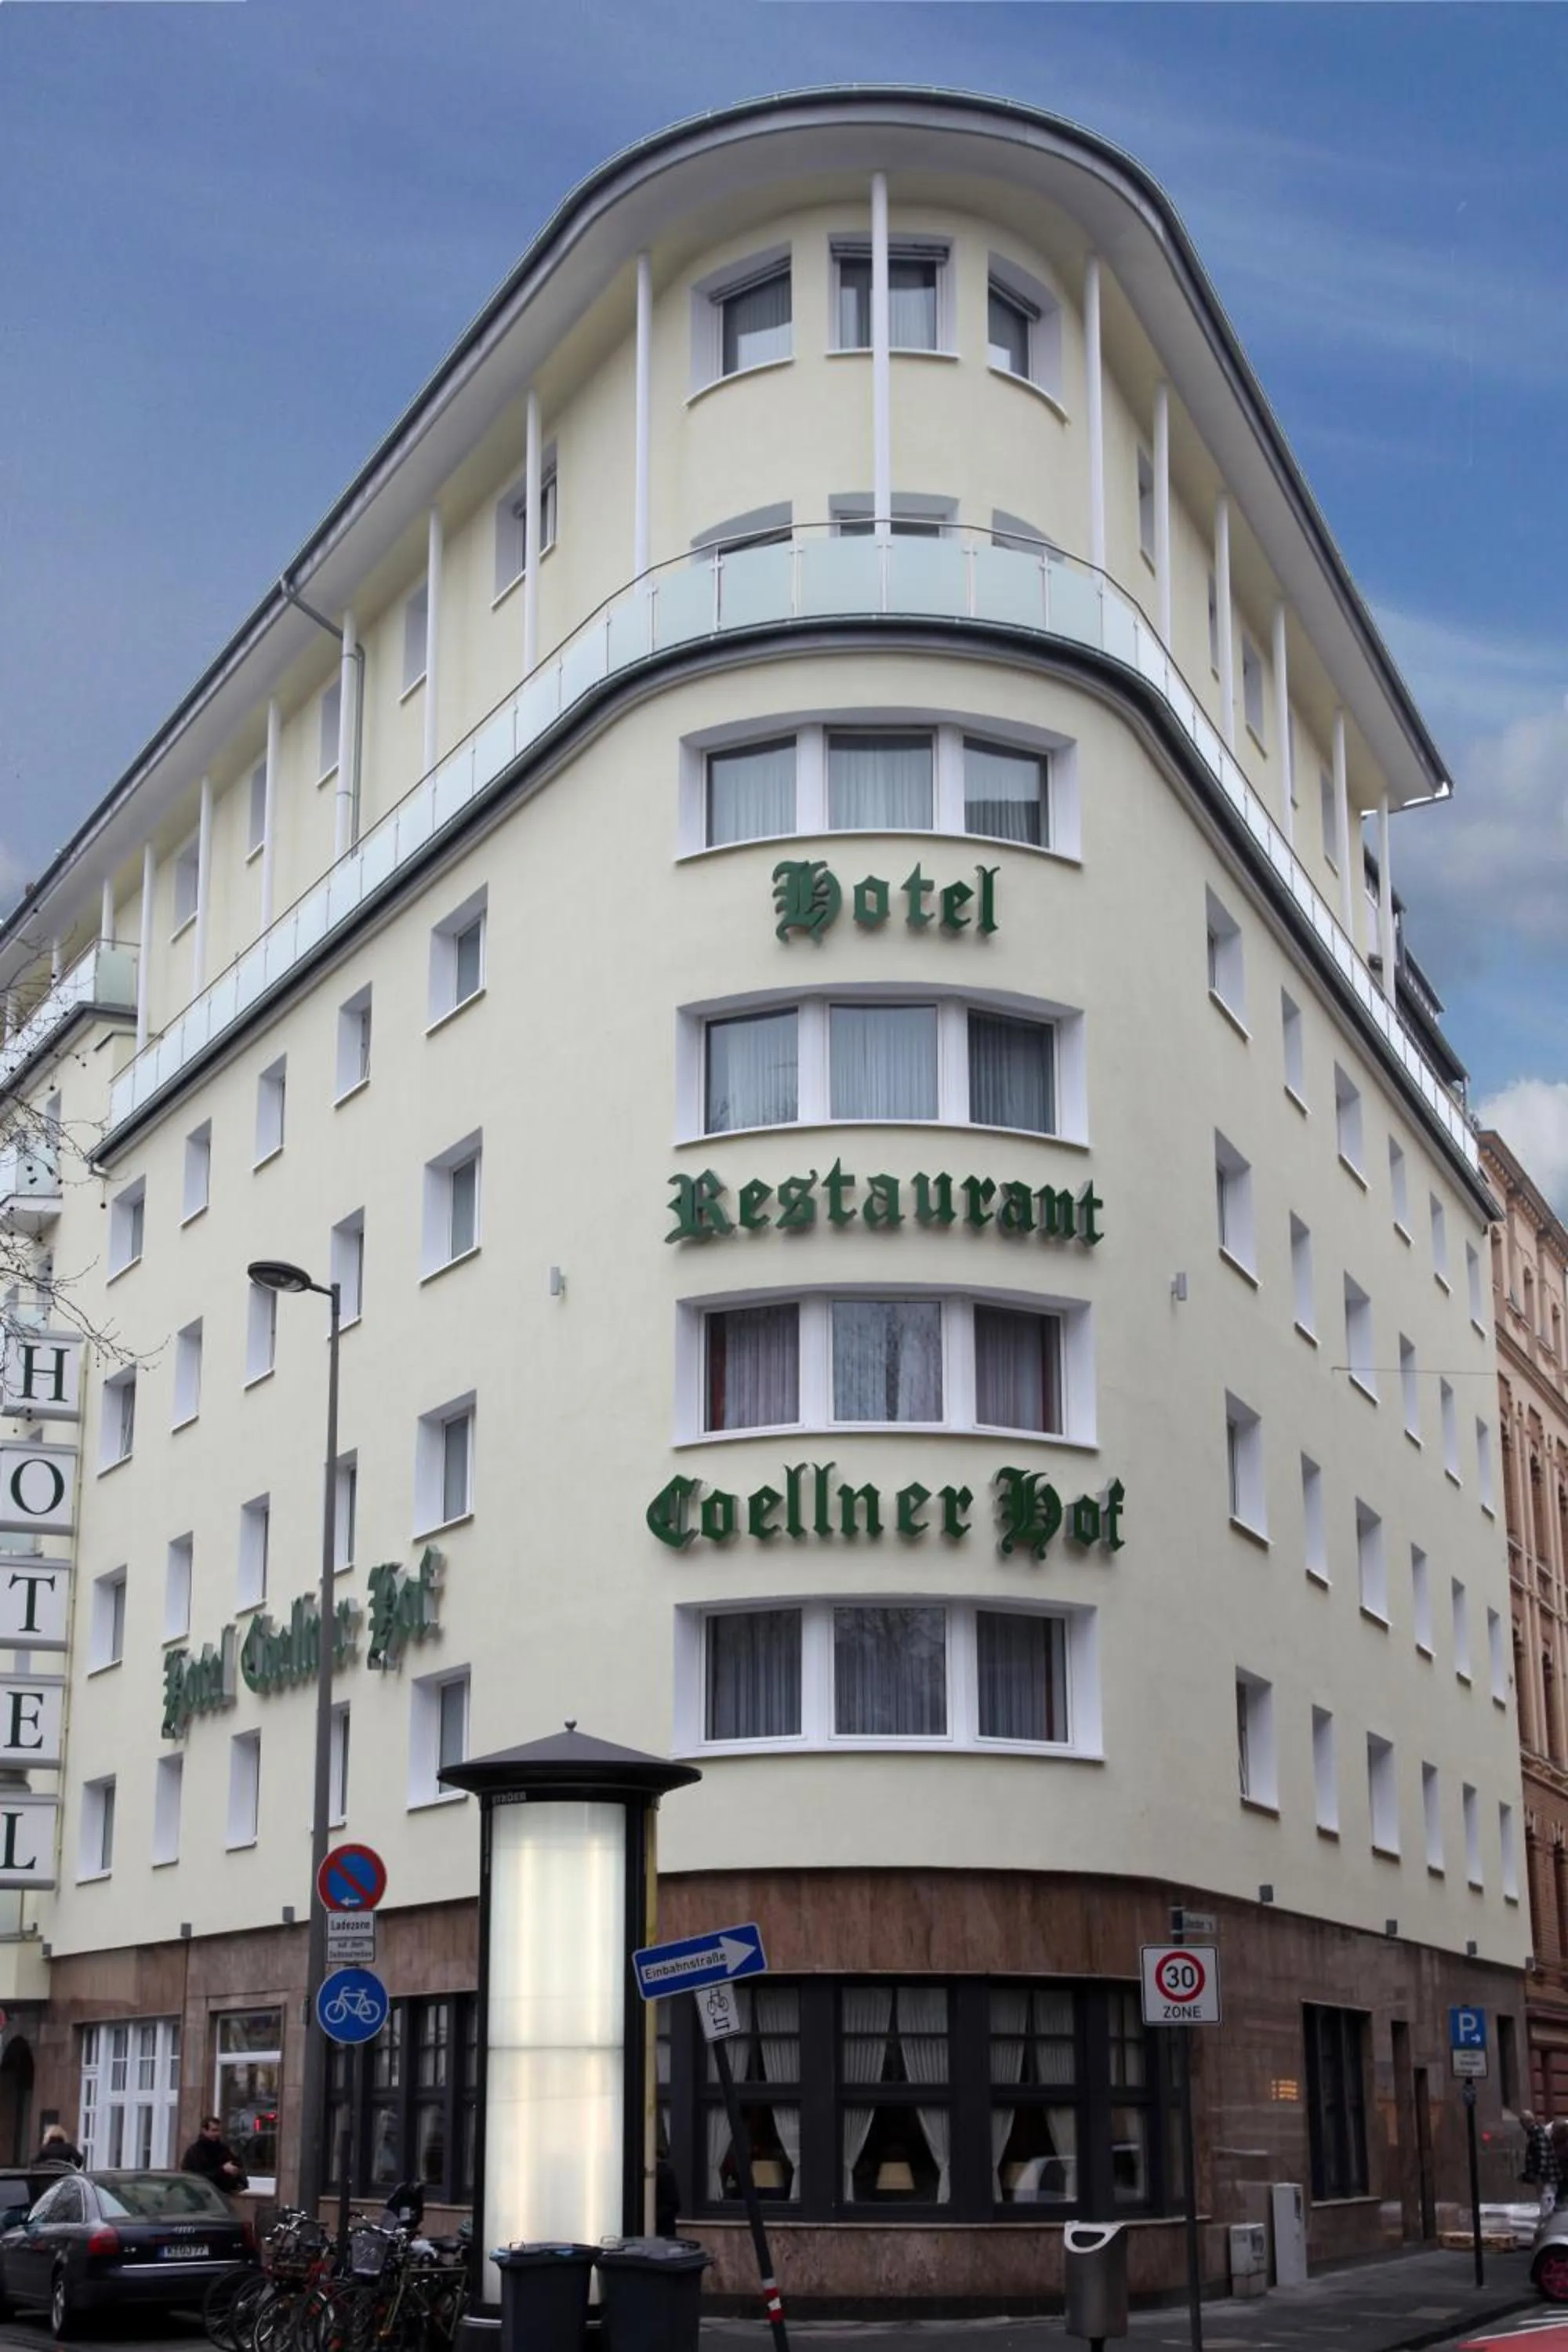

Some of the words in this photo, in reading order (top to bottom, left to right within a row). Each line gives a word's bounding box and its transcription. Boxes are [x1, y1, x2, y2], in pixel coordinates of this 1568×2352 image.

[772, 859, 1001, 943] Hotel
[664, 1156, 1105, 1247] Restaurant
[646, 1461, 974, 1549] Coellner
[993, 1465, 1126, 1560] Hof
[0, 1343, 70, 1871] HOTEL
[240, 1591, 364, 1694] Coellnr
[645, 1951, 727, 1980] Einbahnstraße
[1165, 1965, 1196, 1989] 30
[1163, 2005, 1202, 2019] ZONE
[1458, 2012, 1478, 2042] P
